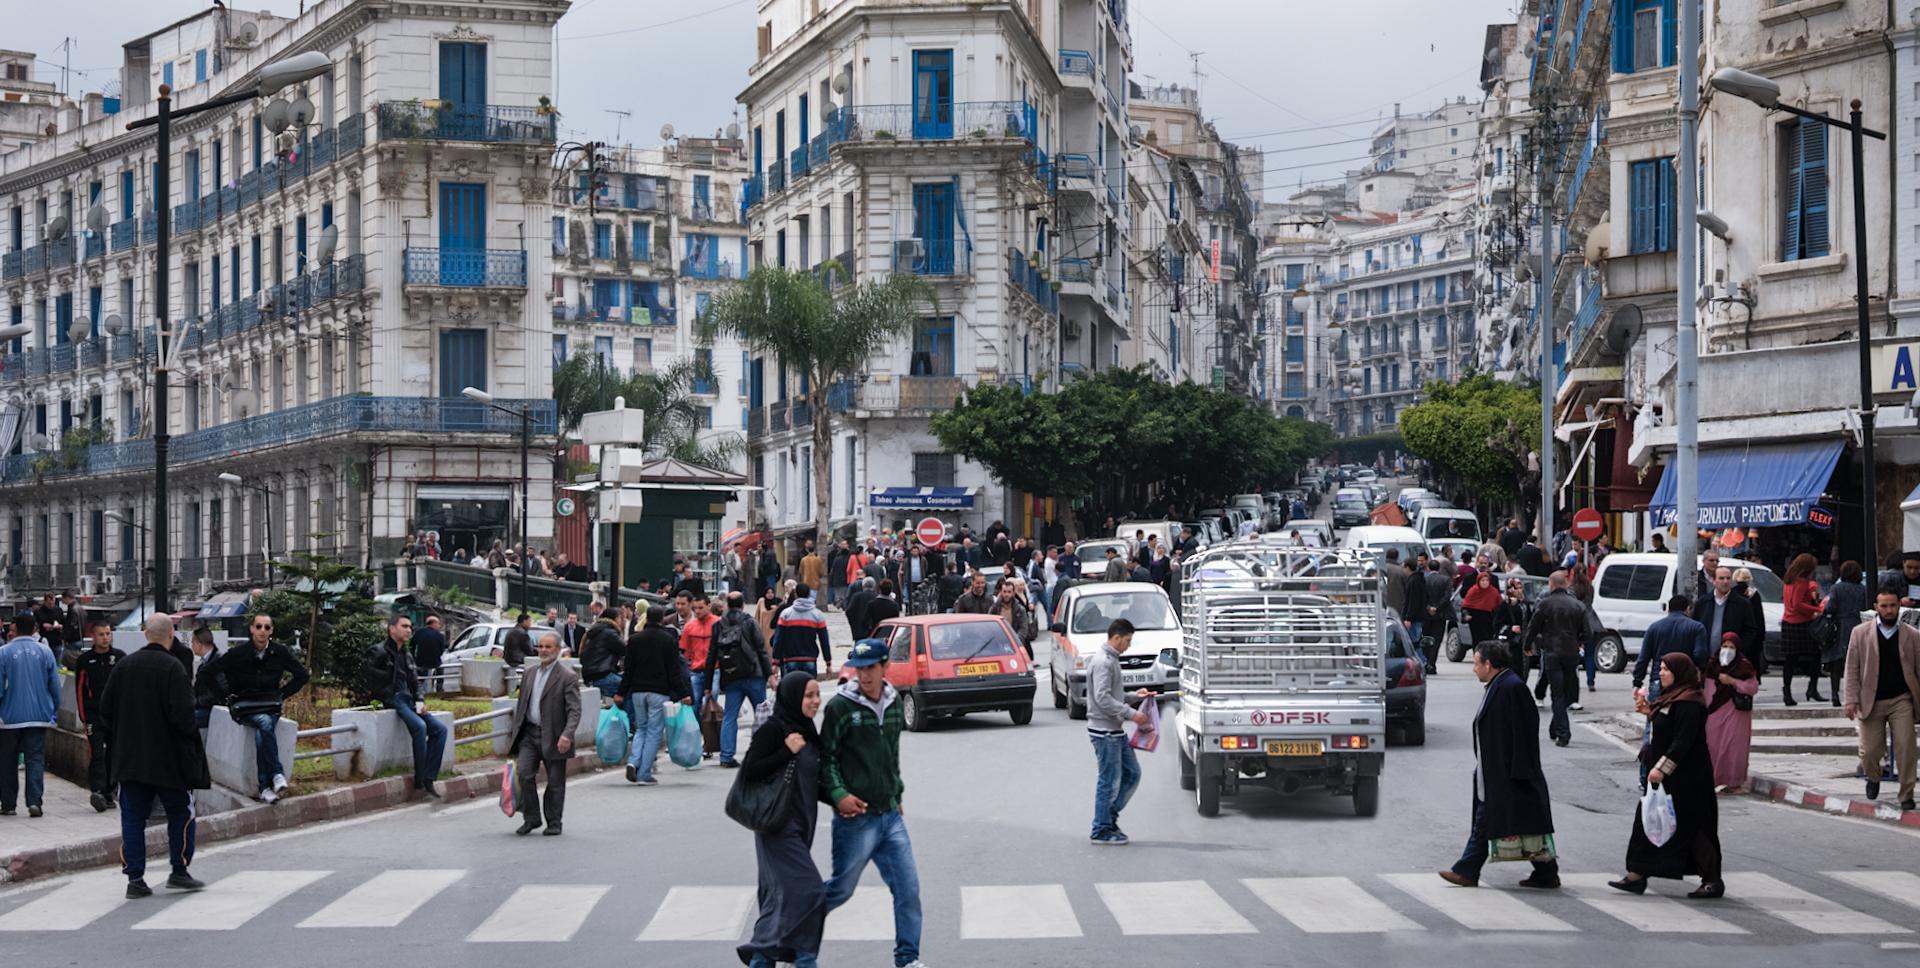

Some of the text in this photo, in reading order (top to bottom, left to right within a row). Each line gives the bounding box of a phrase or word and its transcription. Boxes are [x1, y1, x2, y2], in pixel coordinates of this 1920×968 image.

[1891, 346, 1917, 390] A
[895, 496, 923, 504] Journaux
[1696, 506, 1737, 525] URNAUX
[1270, 712, 1331, 724] DFSK
